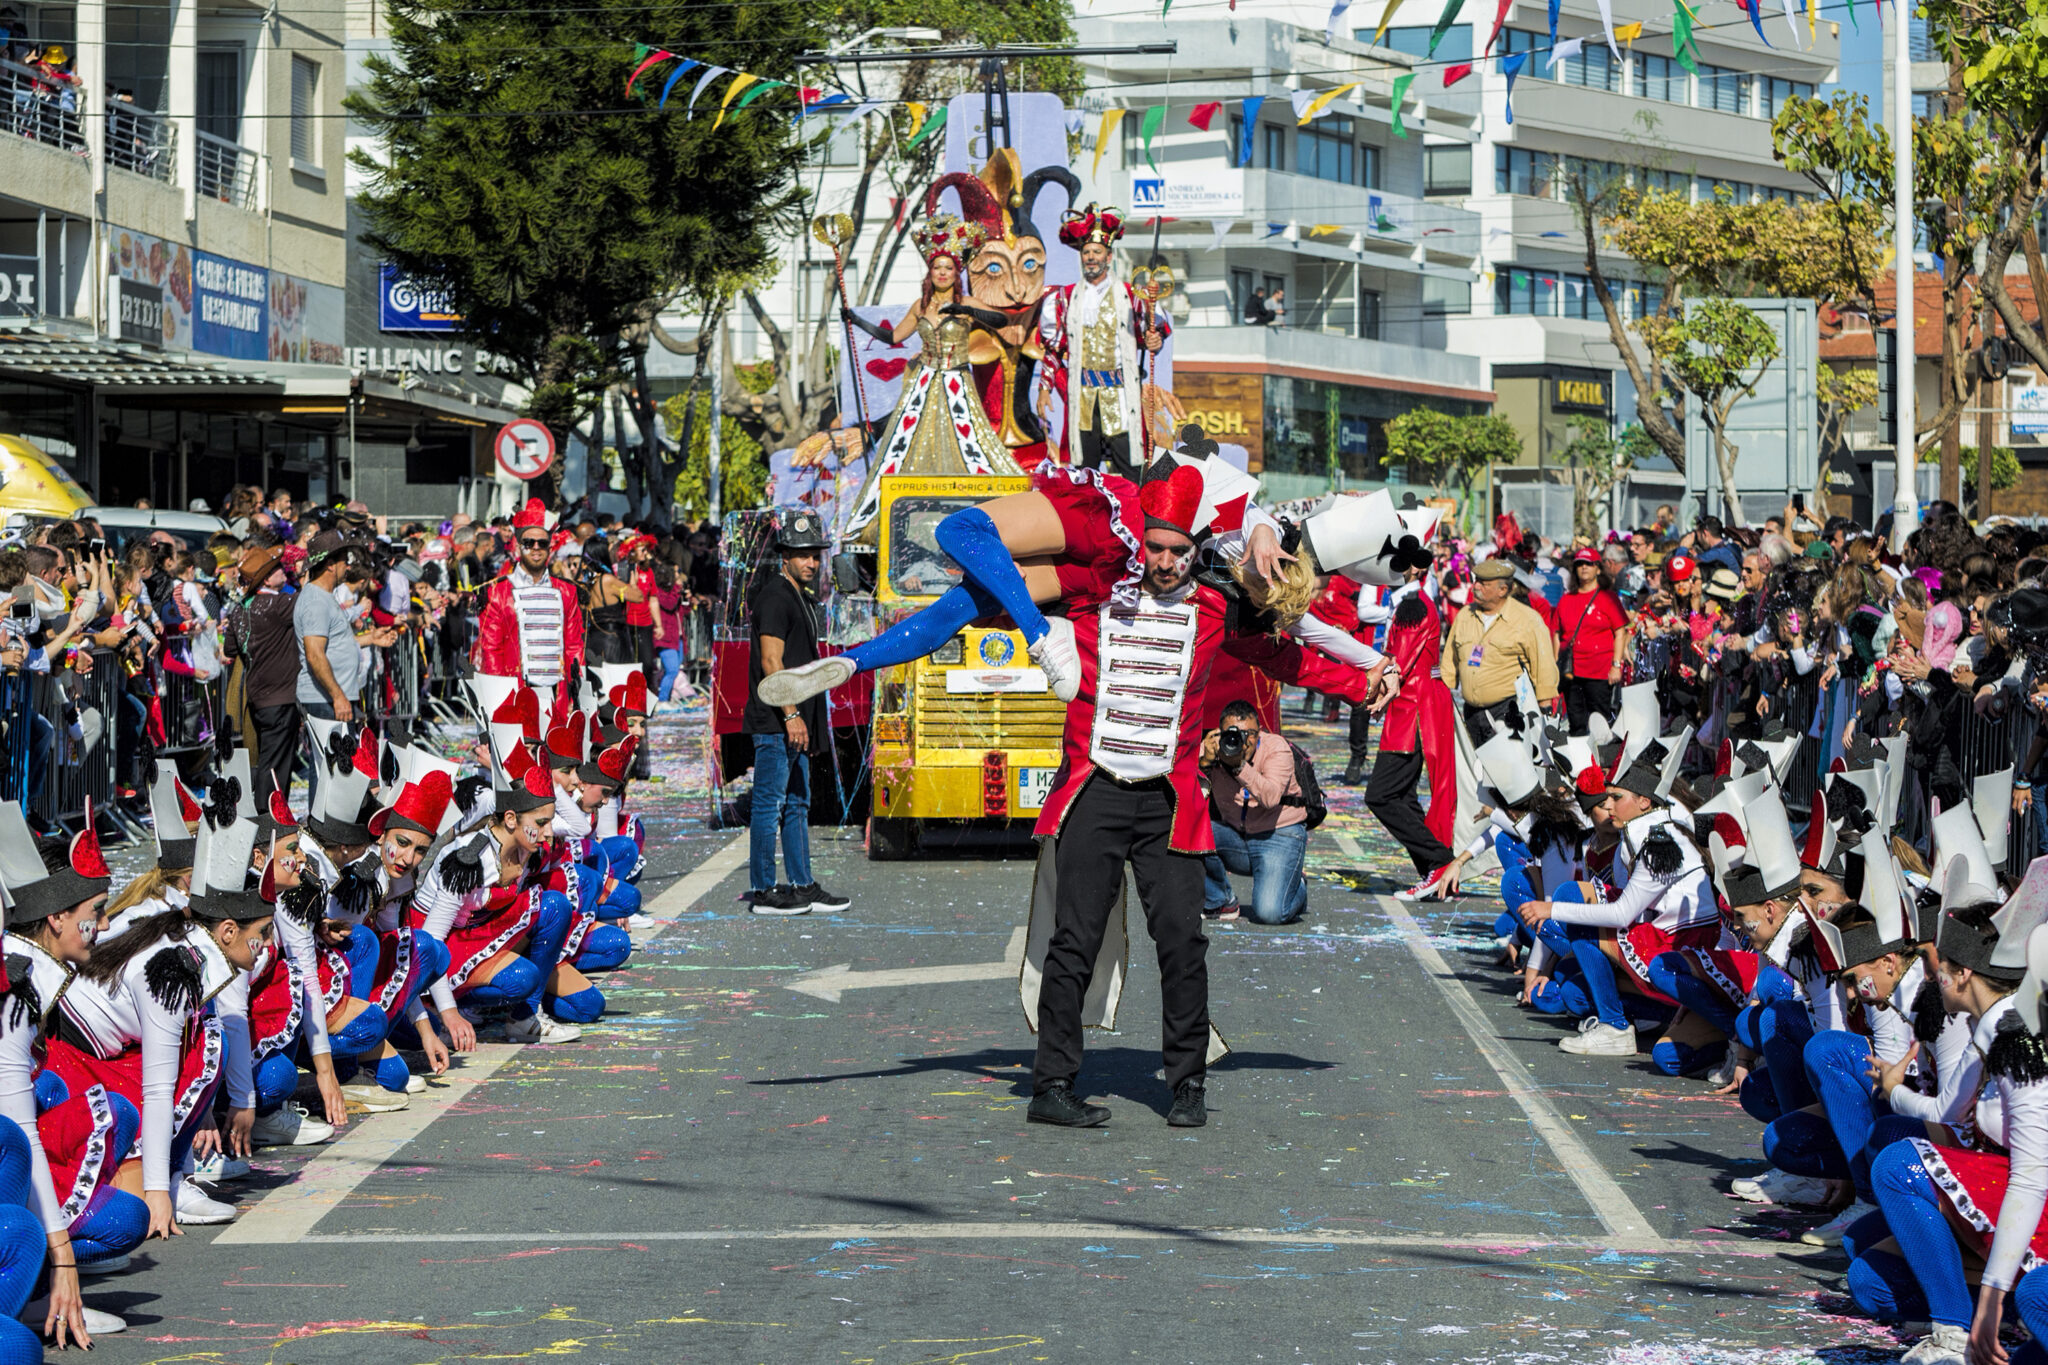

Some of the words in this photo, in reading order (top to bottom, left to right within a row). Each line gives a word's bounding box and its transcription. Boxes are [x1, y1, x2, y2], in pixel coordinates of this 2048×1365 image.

[1134, 185, 1165, 201] AM
[121, 293, 162, 330] BIDI
[475, 350, 532, 375] BA
[890, 483, 929, 491] CYPRUS
[931, 483, 983, 492] HISTORIC
[997, 483, 1028, 492] CLASS
